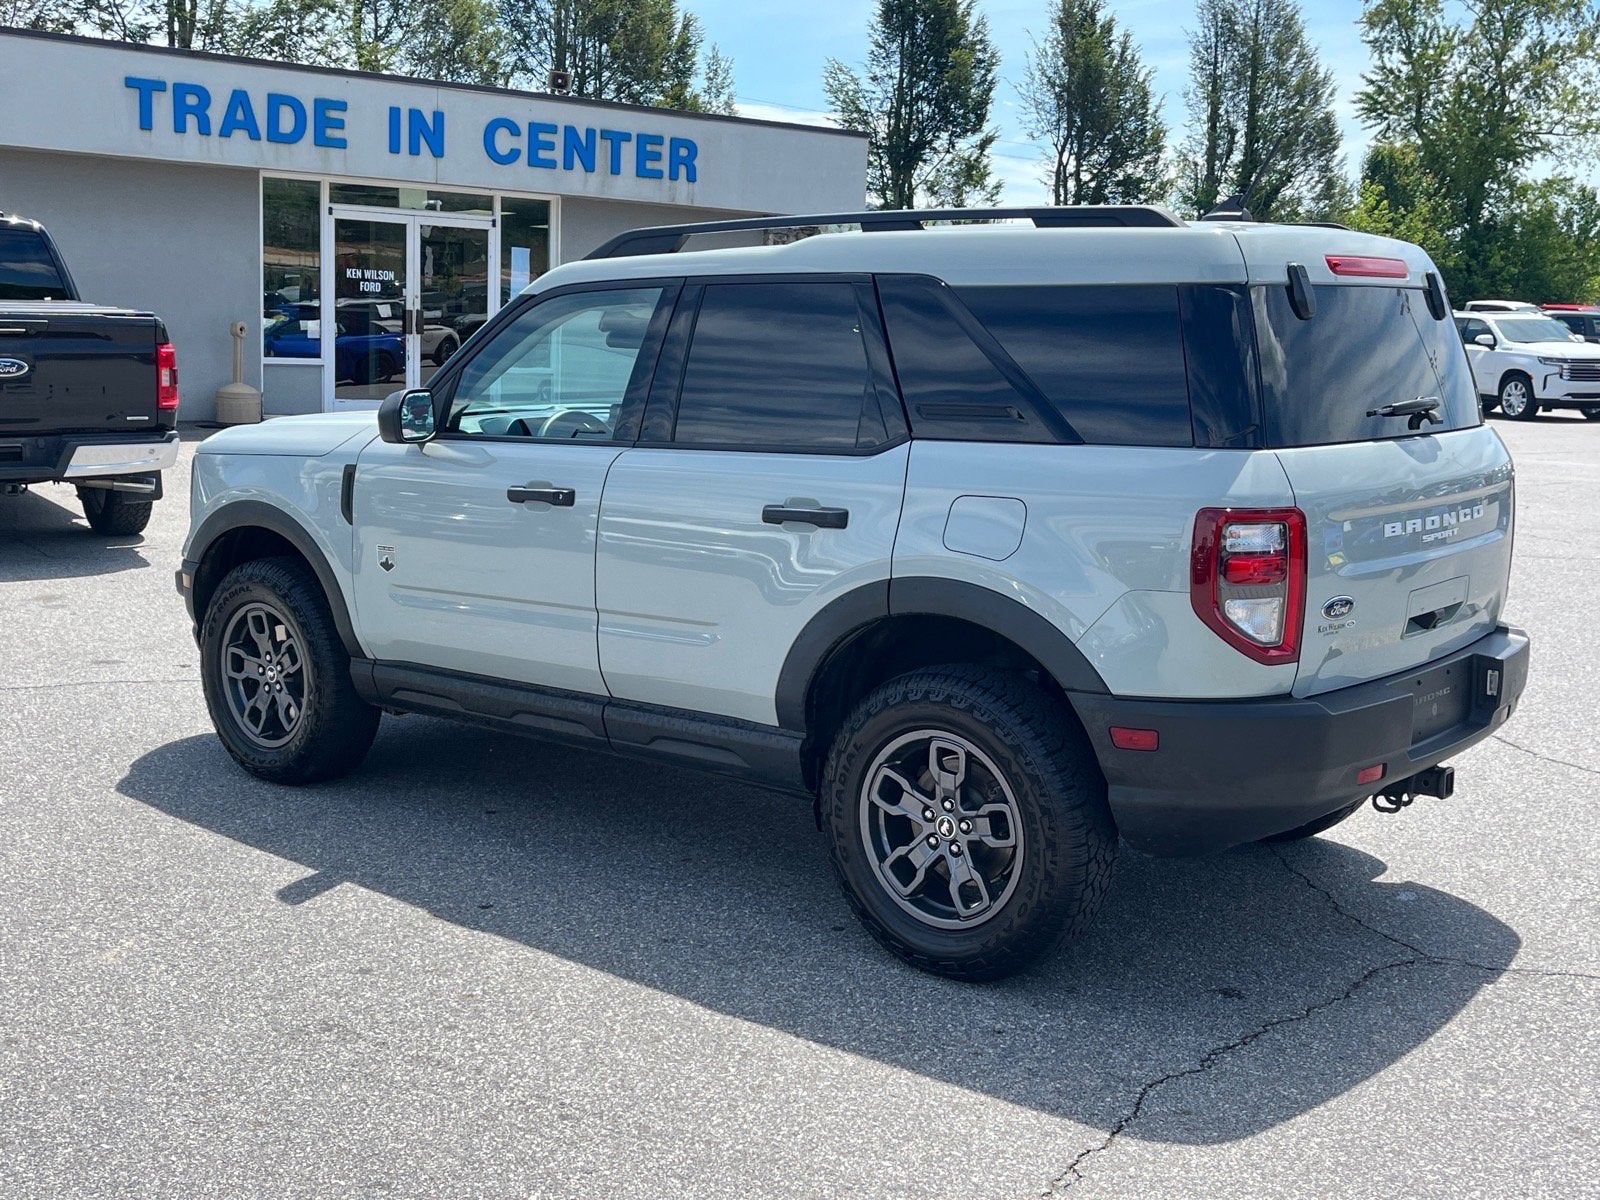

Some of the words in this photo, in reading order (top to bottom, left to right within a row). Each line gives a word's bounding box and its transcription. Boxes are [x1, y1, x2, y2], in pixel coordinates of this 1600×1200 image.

[125, 76, 348, 149] TRADE
[388, 106, 445, 158] IN
[483, 117, 699, 183] CENTER
[346, 267, 362, 279] KEN
[364, 269, 395, 280] WILSON
[360, 281, 381, 292] FORD
[1384, 504, 1484, 538] BRONCO
[1422, 527, 1460, 543] SPORT
